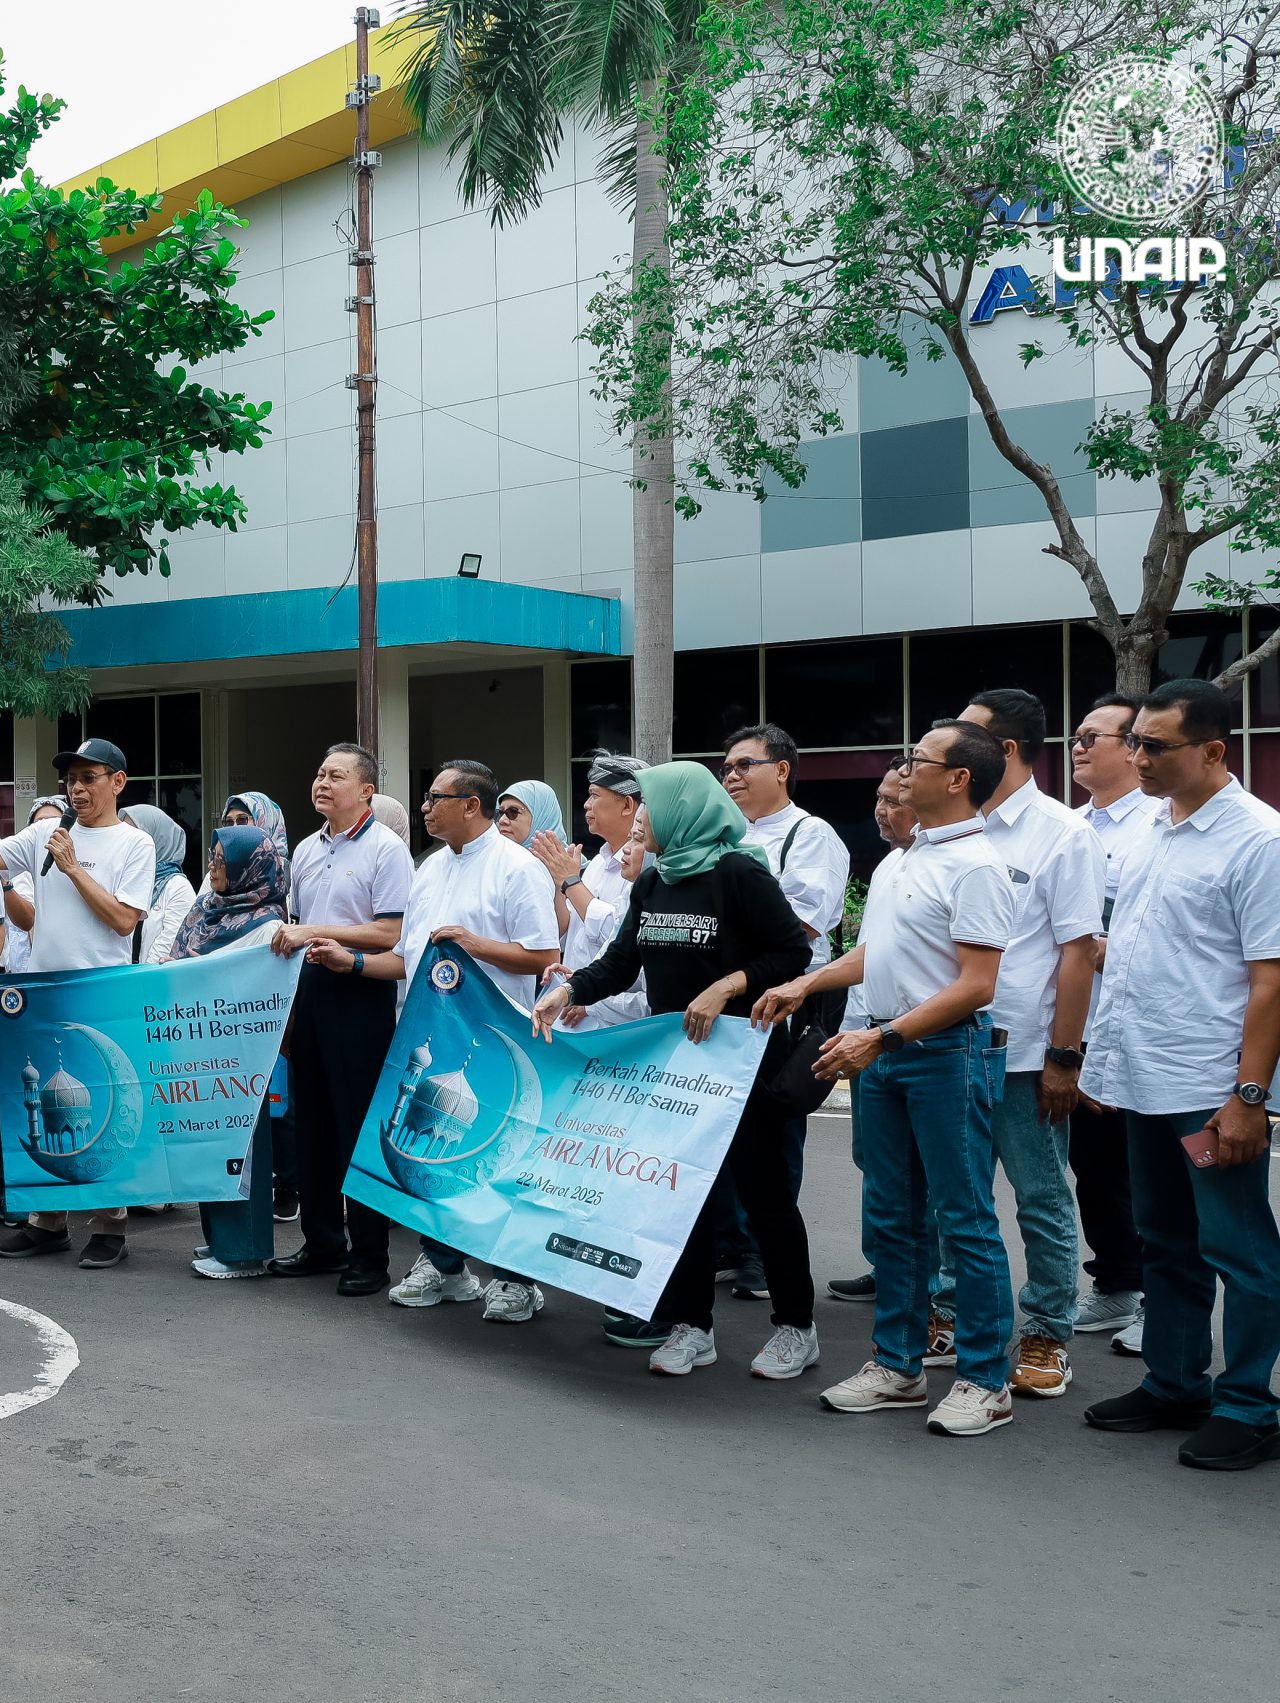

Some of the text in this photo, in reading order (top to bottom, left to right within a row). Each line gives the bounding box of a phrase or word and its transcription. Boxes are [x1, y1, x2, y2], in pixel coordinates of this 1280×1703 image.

[143, 1000, 208, 1023] Berkah
[145, 1019, 283, 1043] 1446 H Bersama
[149, 1057, 240, 1076] Universitas
[583, 1057, 734, 1098] Berkah Ramadhan
[571, 1078, 699, 1117] 1446 H Bersama
[157, 1121, 175, 1134] 22
[178, 1118, 220, 1133] Maret
[554, 1111, 627, 1139] Universitas
[532, 1135, 679, 1191] AIRLANGGA
[515, 1171, 605, 1206] 22 Maret 2025
